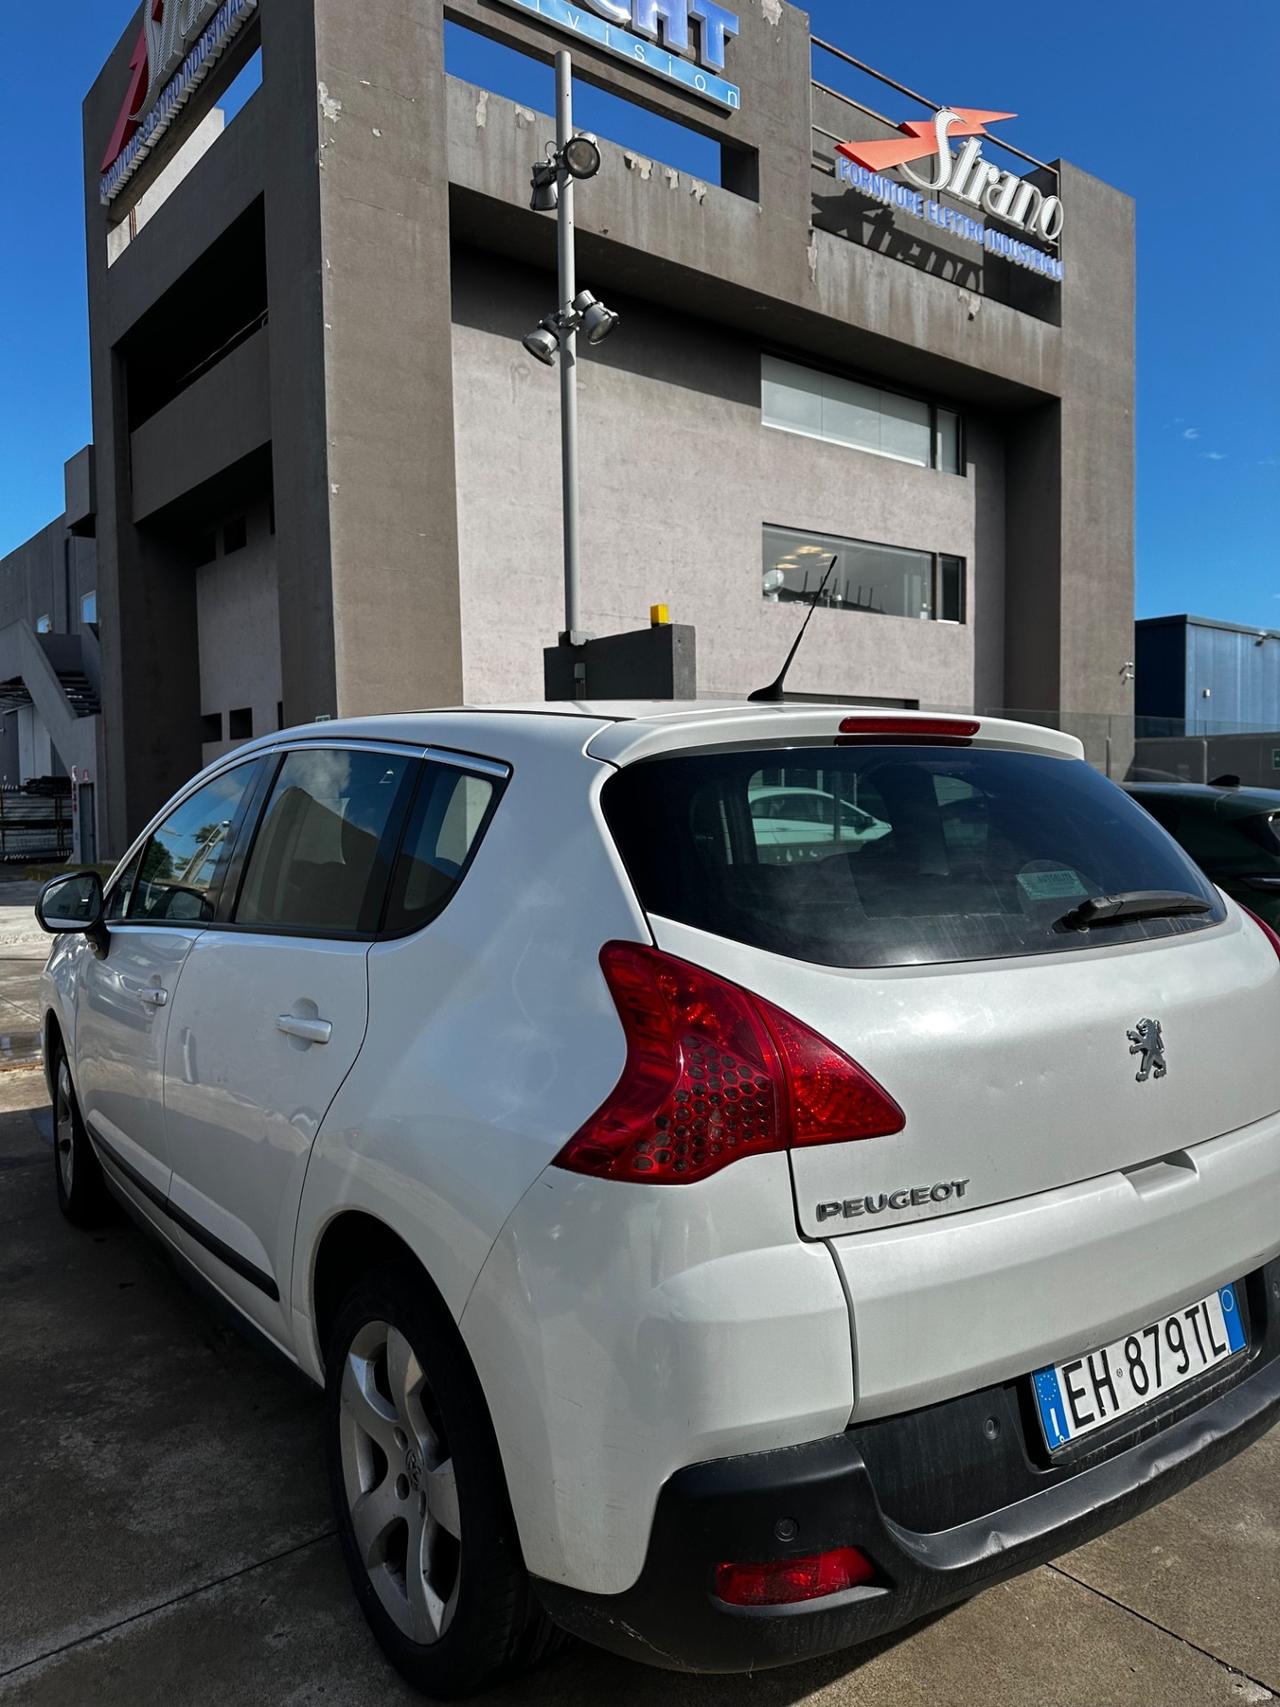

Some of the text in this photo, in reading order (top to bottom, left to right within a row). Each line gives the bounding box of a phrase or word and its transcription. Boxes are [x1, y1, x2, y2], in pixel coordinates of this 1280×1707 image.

[836, 156, 925, 220] FORNITURE
[899, 106, 1064, 242] Strano
[816, 1178, 970, 1222] PEUGEOT
